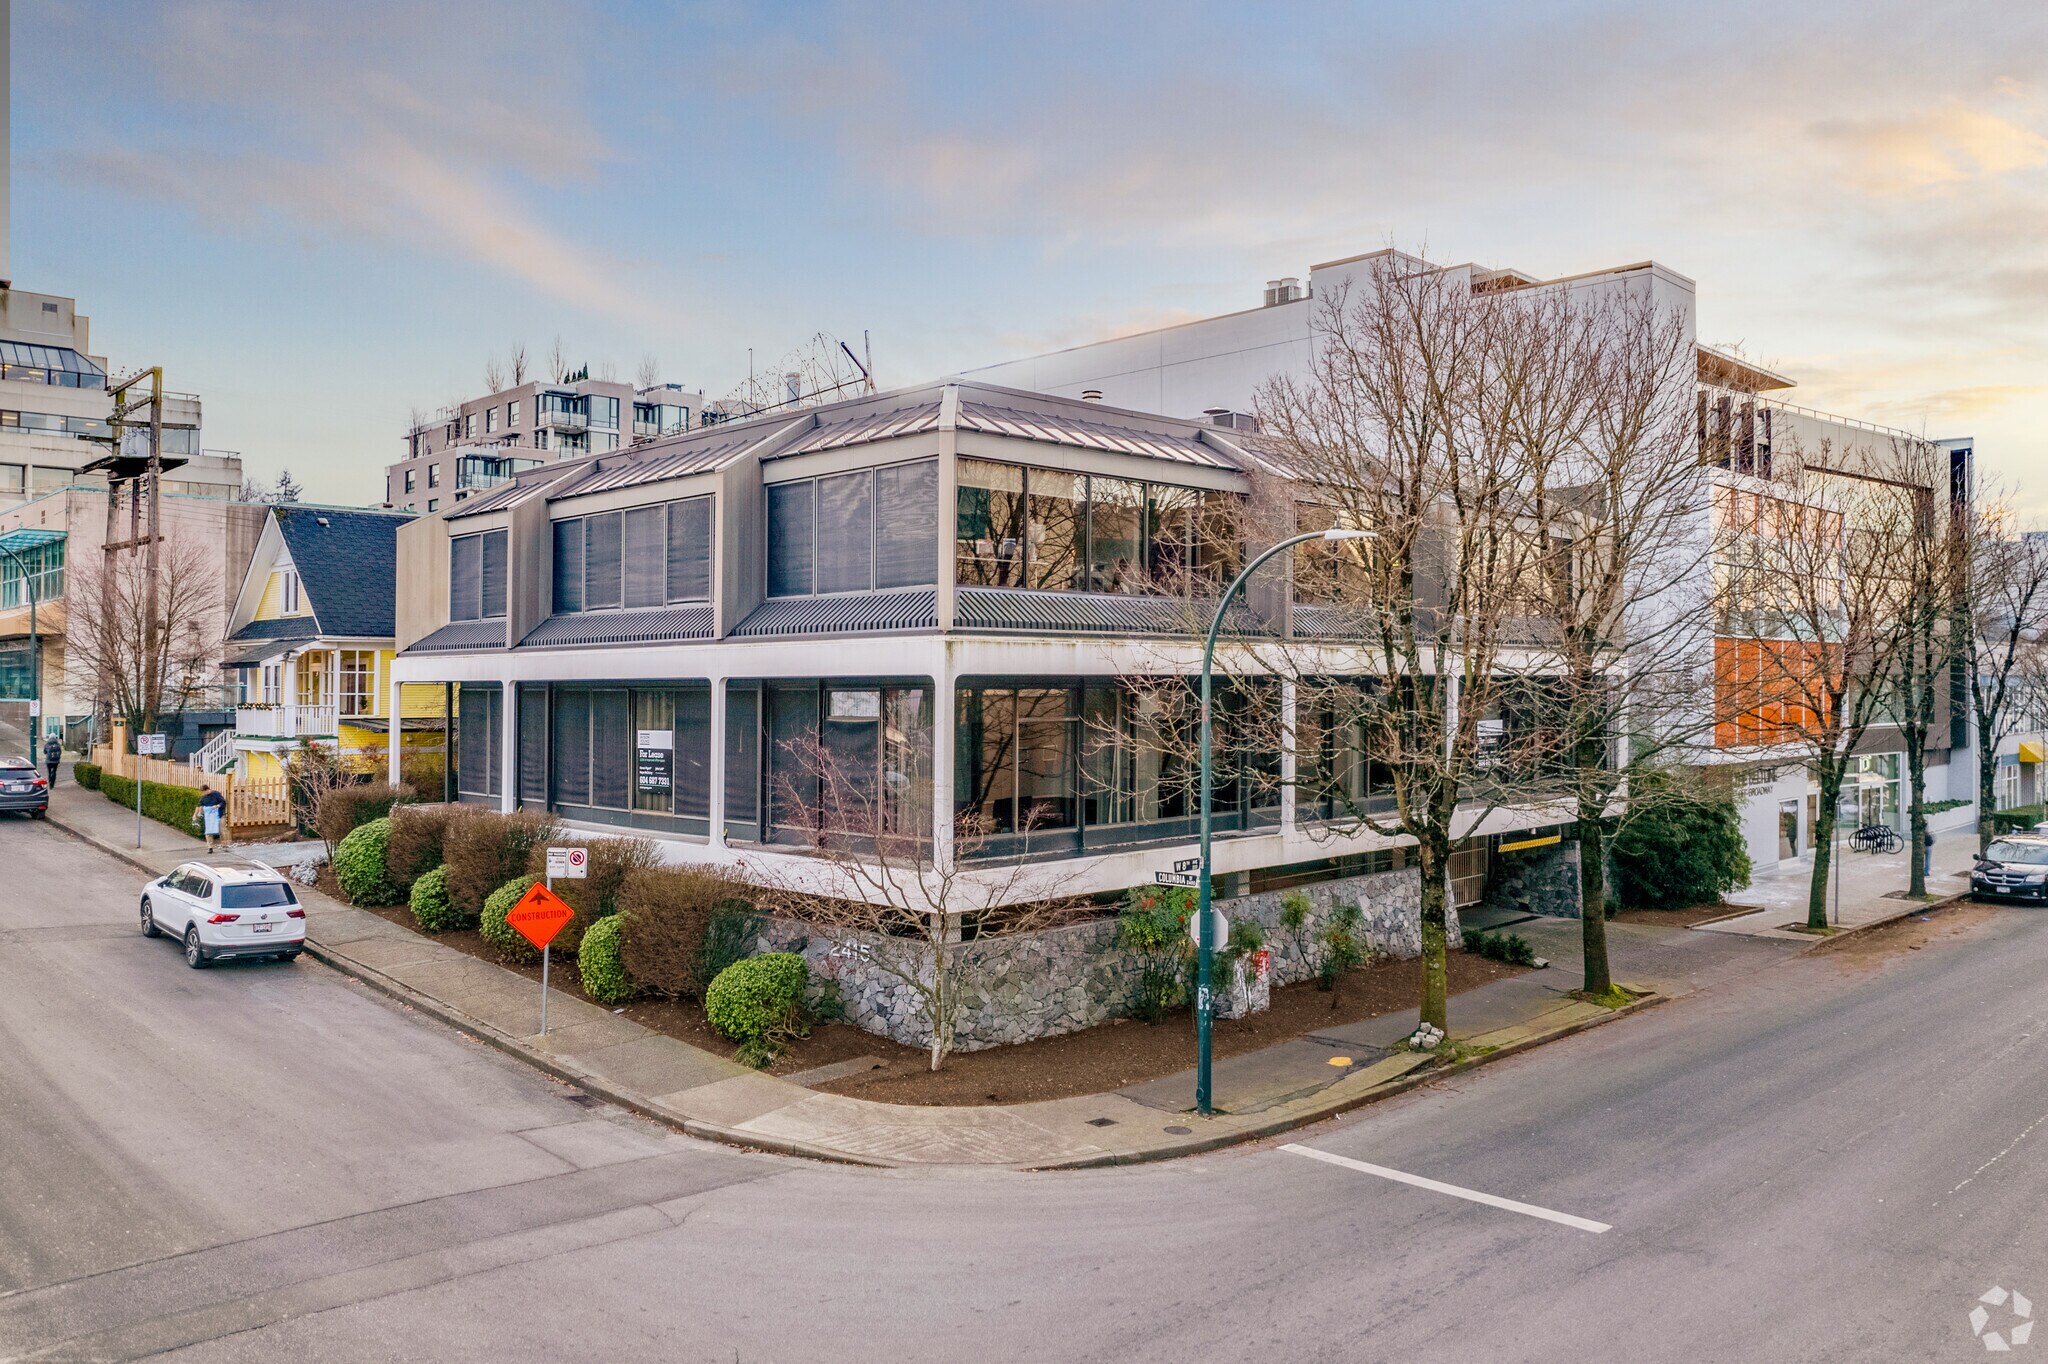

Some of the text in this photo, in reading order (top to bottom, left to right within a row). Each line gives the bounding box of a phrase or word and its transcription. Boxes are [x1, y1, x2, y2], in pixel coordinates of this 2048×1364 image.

[639, 750, 648, 758] For
[1175, 862, 1181, 871] W
[1158, 873, 1185, 885] COLUMBIA
[511, 910, 567, 922] CONSTRUCTION
